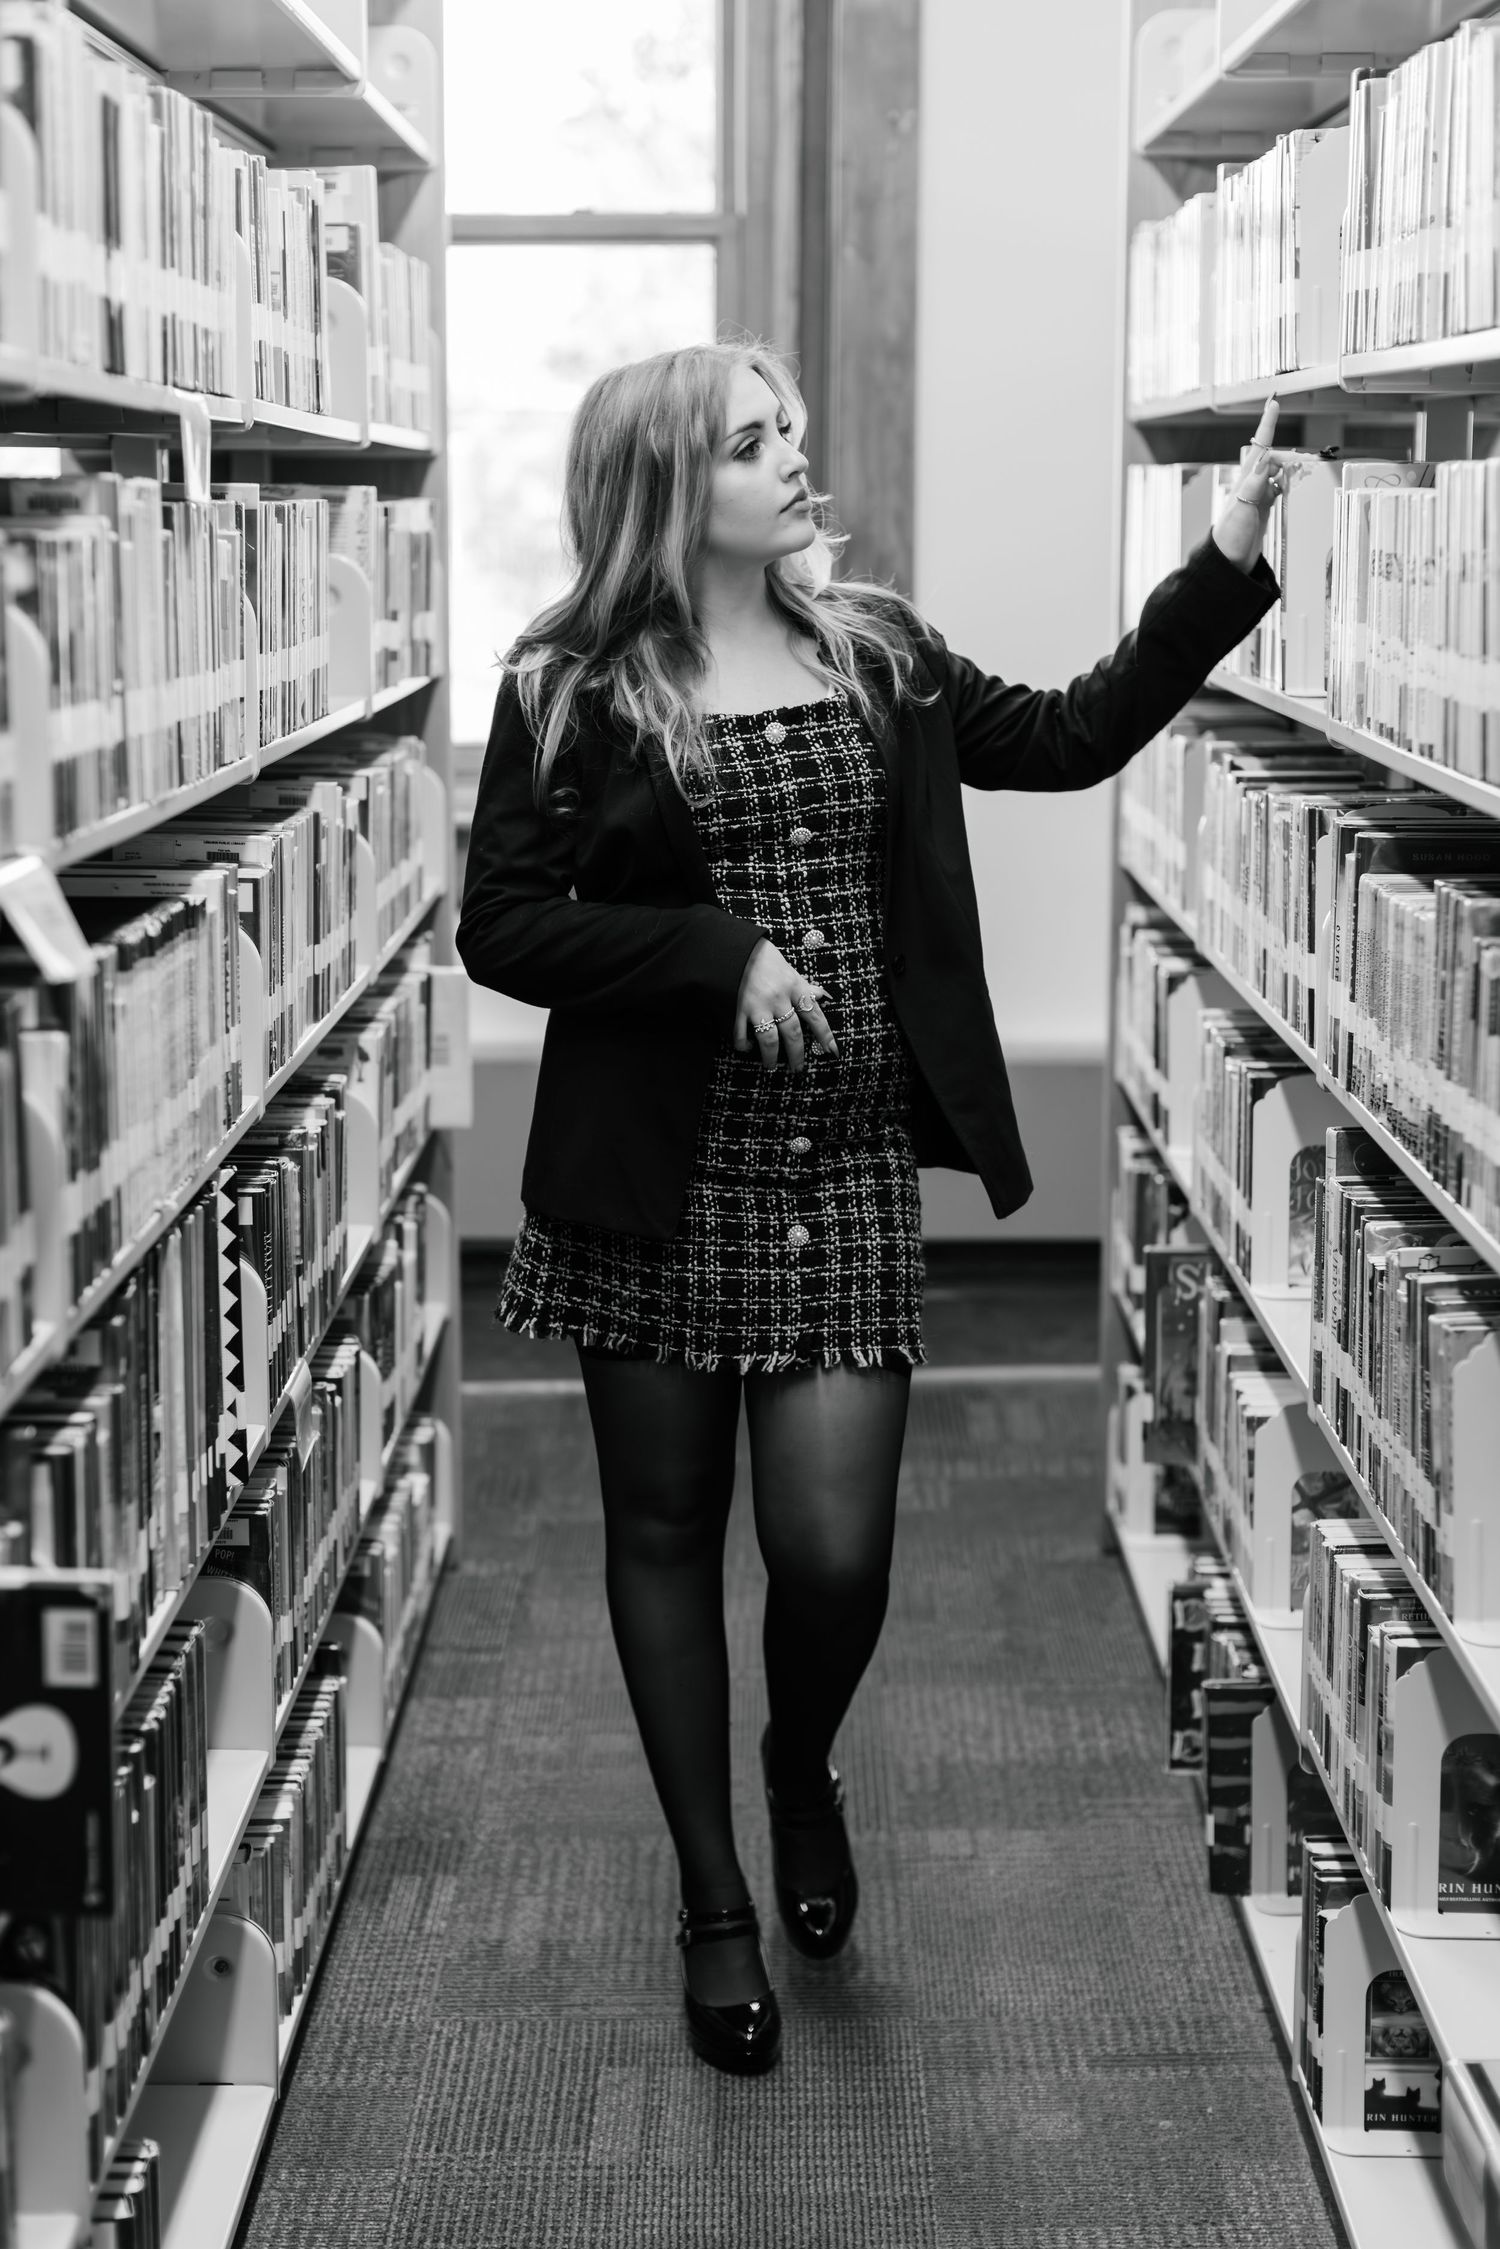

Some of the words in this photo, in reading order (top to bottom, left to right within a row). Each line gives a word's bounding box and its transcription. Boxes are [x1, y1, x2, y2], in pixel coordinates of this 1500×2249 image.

[1412, 852, 1451, 862] SUSAN
[1438, 1882, 1465, 1894] RIN
[1366, 2112, 1386, 2122] RIN
[1391, 2113, 1438, 2123] HUNTER
